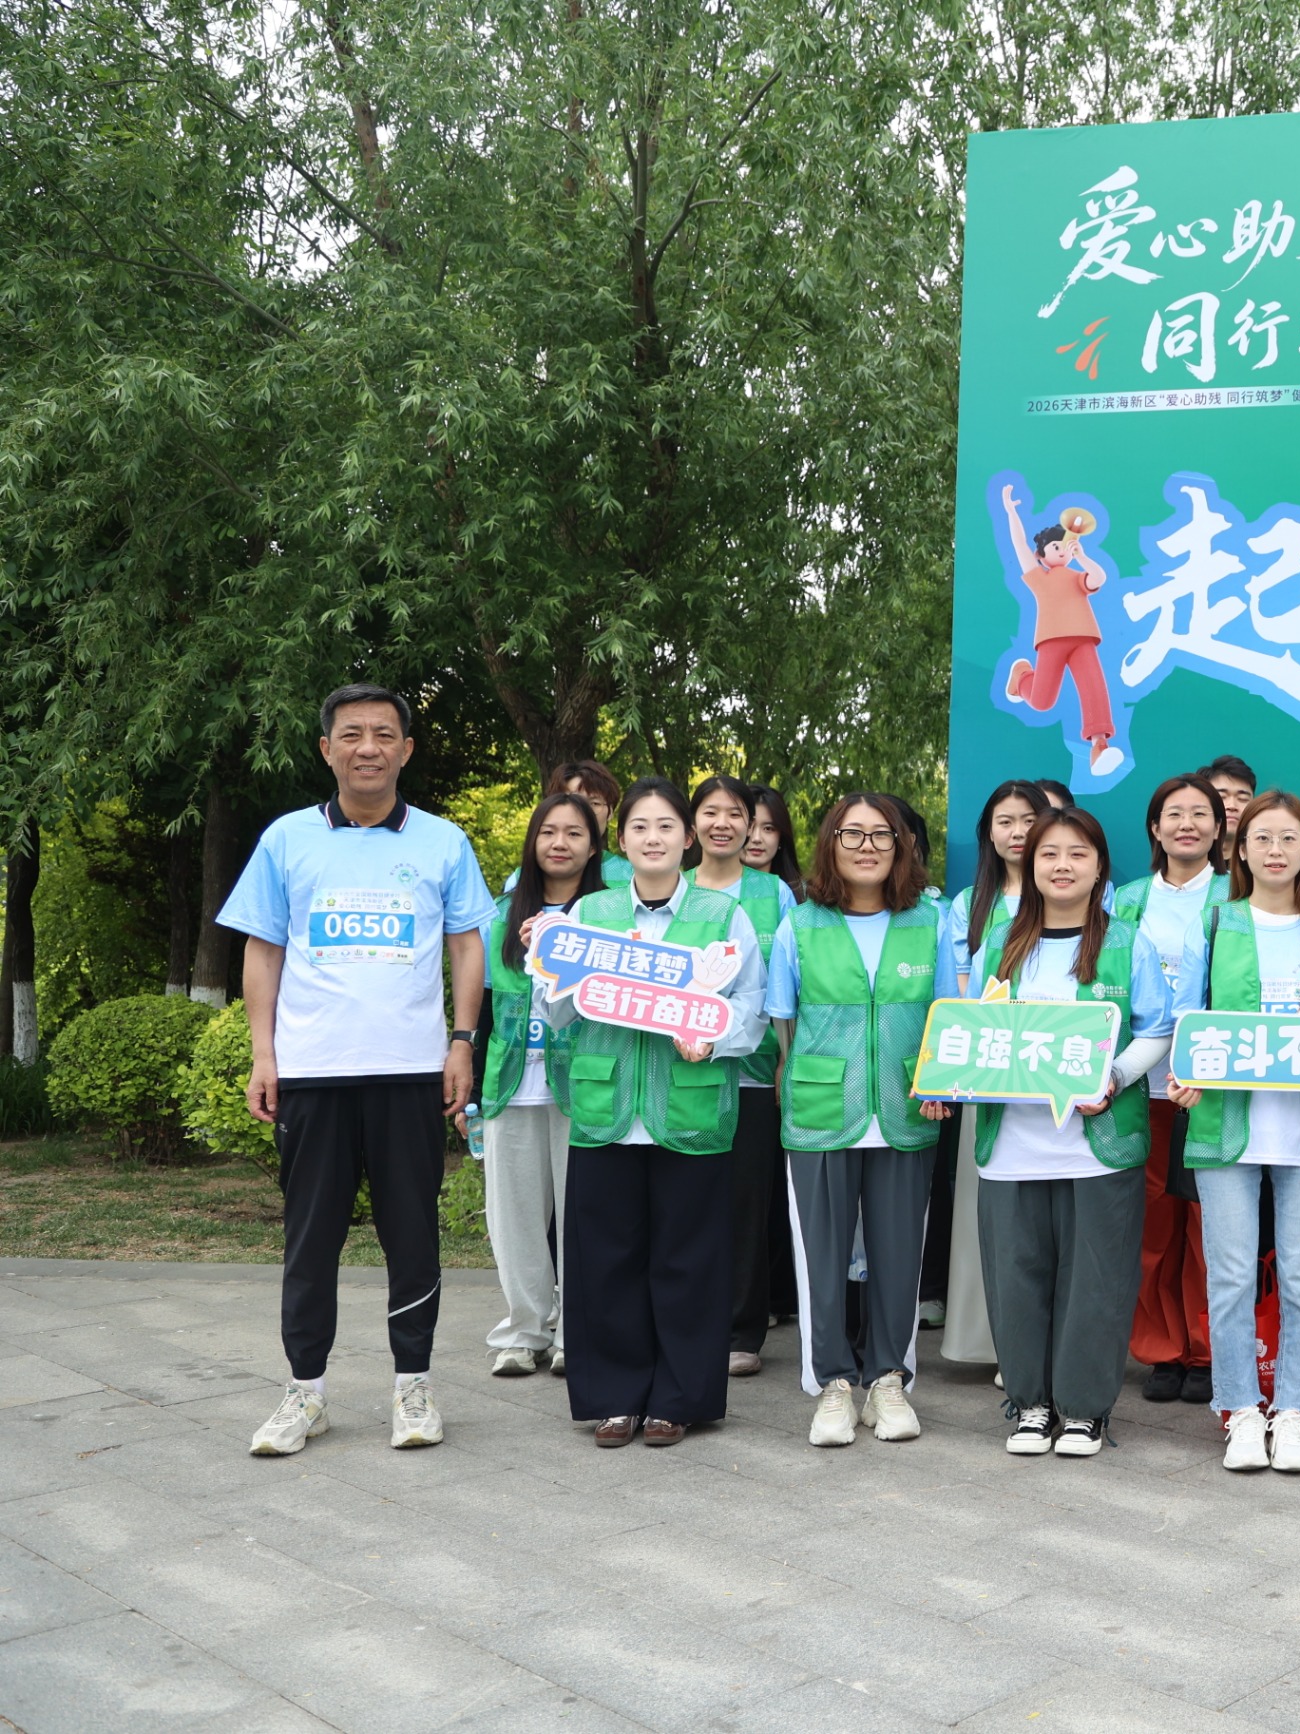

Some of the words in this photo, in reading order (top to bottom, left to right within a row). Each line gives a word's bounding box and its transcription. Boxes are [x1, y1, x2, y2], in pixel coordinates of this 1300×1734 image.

[324, 913, 401, 939] 0650
[550, 931, 689, 985] 步履逐梦
[583, 979, 721, 1035] 笃行奋进
[936, 1024, 1093, 1077] 自强不息
